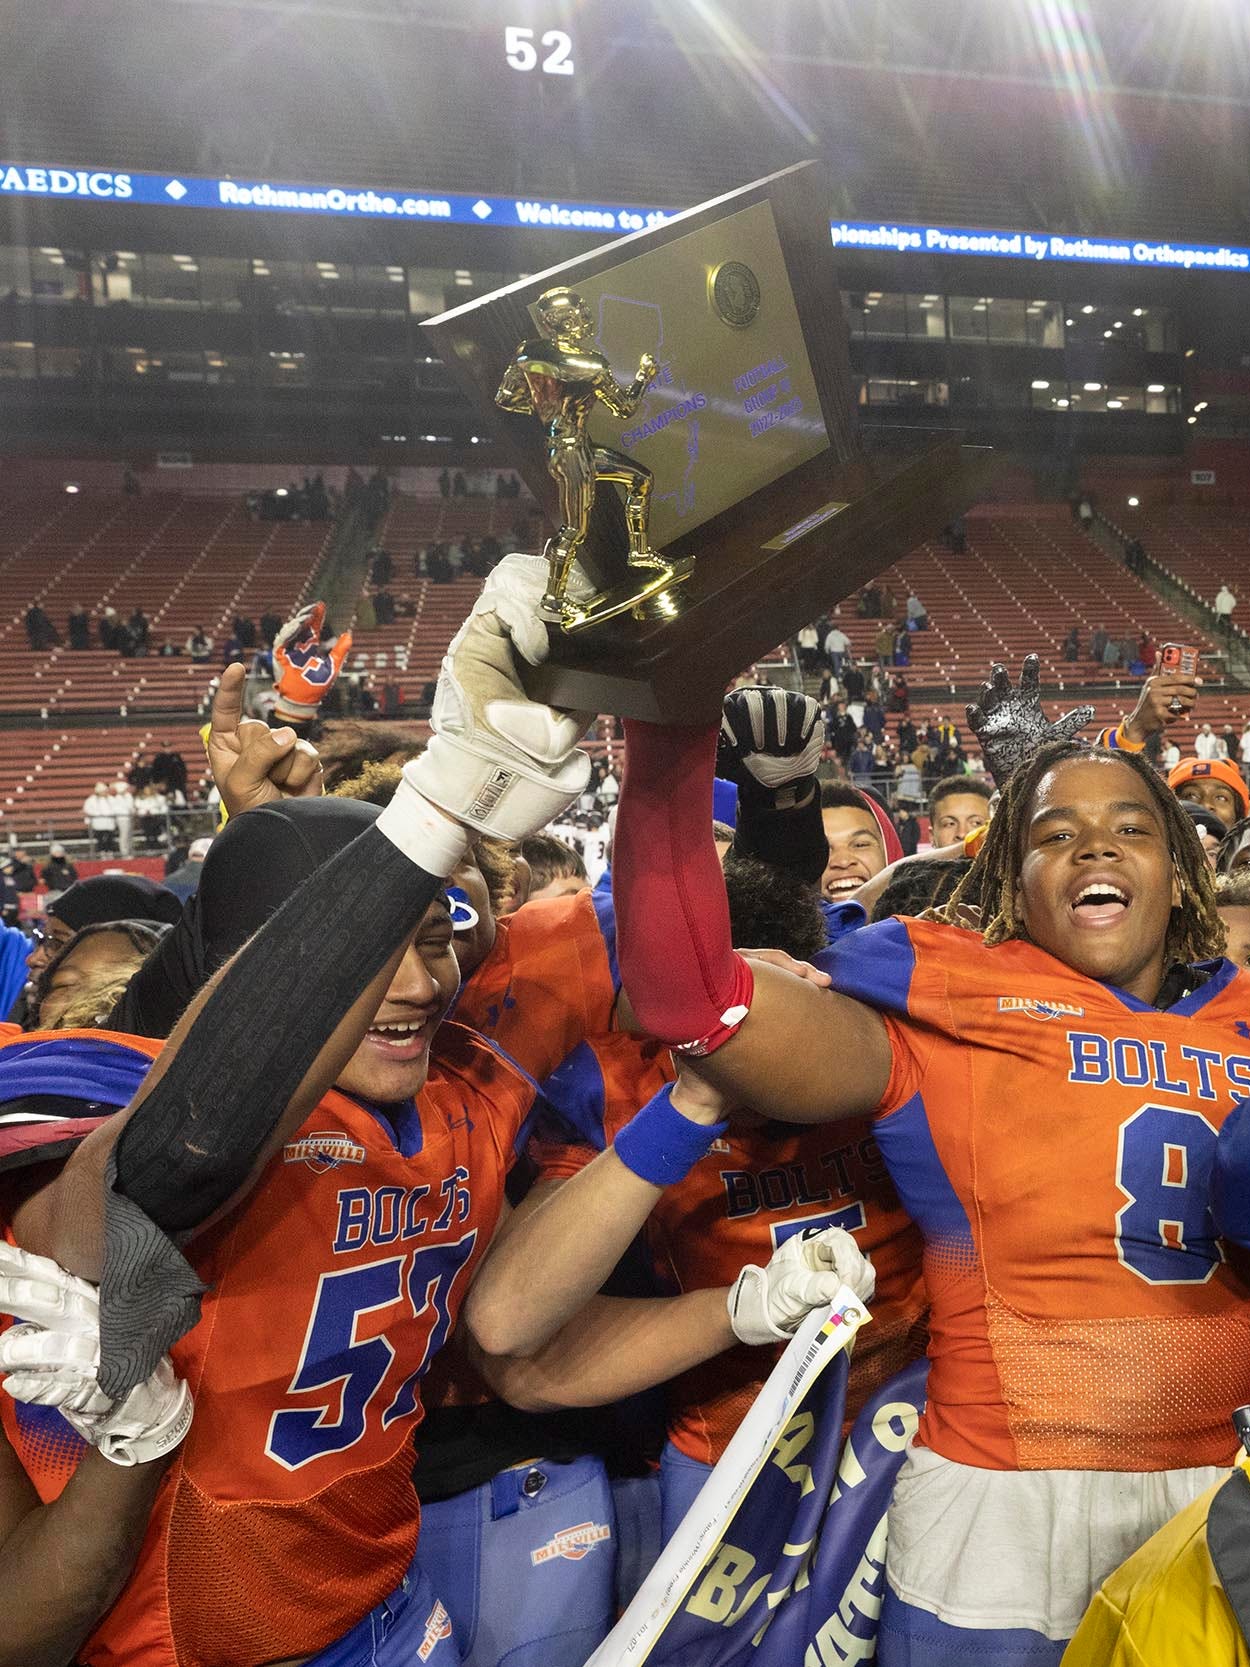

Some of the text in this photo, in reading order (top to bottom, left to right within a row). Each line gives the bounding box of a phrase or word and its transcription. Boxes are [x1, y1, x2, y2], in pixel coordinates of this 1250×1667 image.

[505, 26, 574, 75] 52
[219, 181, 451, 217] RothmanOrtho.com
[515, 201, 615, 228] Welcome
[618, 211, 643, 230] to
[926, 229, 1022, 254] Presented
[1024, 235, 1048, 260] by
[1050, 237, 1130, 260] Rothman
[1132, 243, 1249, 269] Orthopaedics
[620, 393, 707, 448] CHAMPIONS
[332, 1166, 470, 1255] BOLTS
[1114, 1102, 1227, 1286] 8
[264, 1228, 479, 1472] 57
